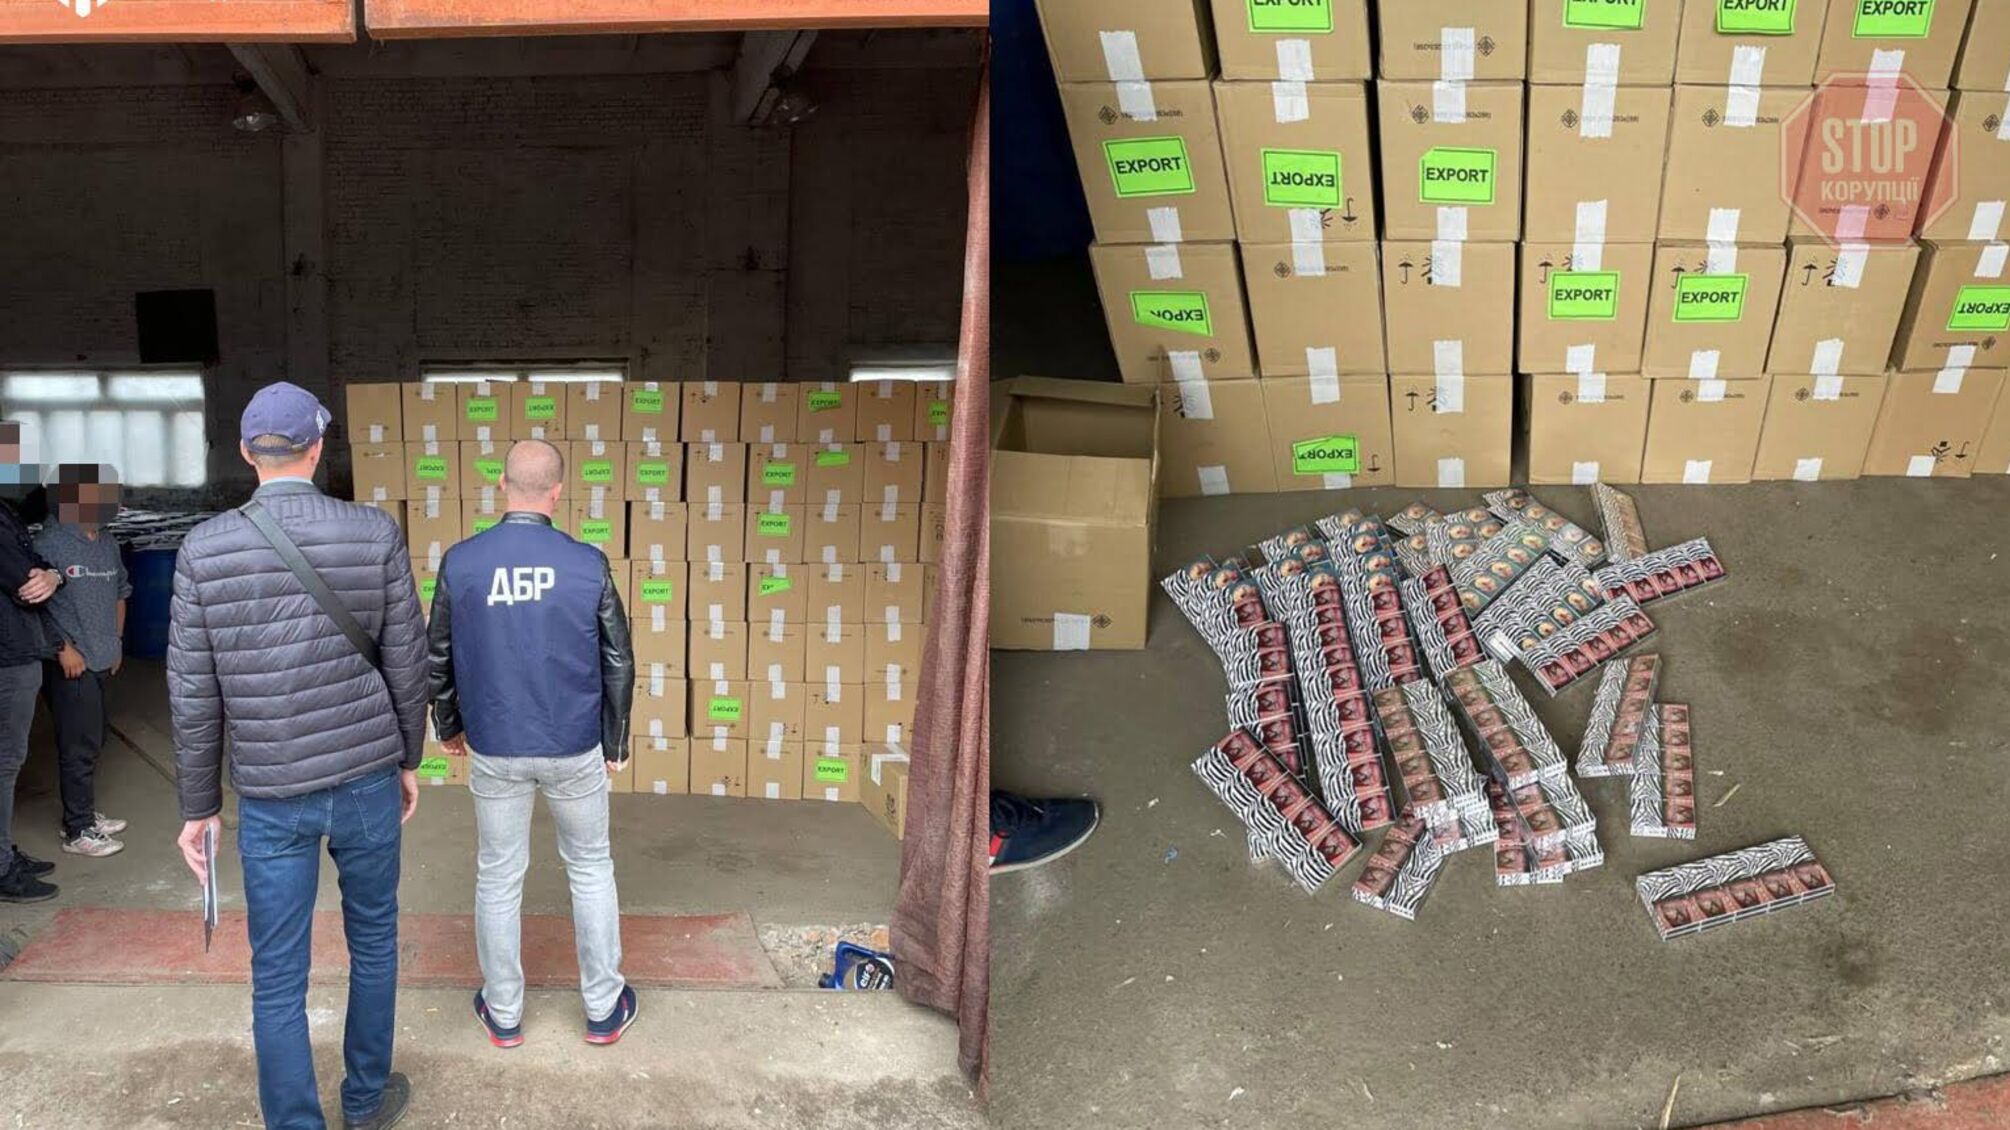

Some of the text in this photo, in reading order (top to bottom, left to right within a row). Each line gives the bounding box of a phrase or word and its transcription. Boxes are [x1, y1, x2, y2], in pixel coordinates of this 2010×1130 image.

[1861, 1, 1928, 16] EXPORT
[1115, 156, 1181, 175] EXPORT
[1270, 171, 1335, 188] EXPORT
[1425, 167, 1489, 183] EXPORT
[1554, 287, 1612, 302] EXPORT
[1680, 290, 1740, 304] EXPORT
[1957, 302, 2010, 314] EXPORT
[634, 397, 662, 406] EXPORT
[639, 469, 666, 477] EXPORT
[765, 470, 793, 479] EXPORT
[761, 520, 788, 529] EXPORT
[582, 527, 609, 535] EXPORT
[487, 567, 555, 606] ДБР
[643, 587, 670, 596] EXPORT
[817, 765, 846, 775] EXPORT
